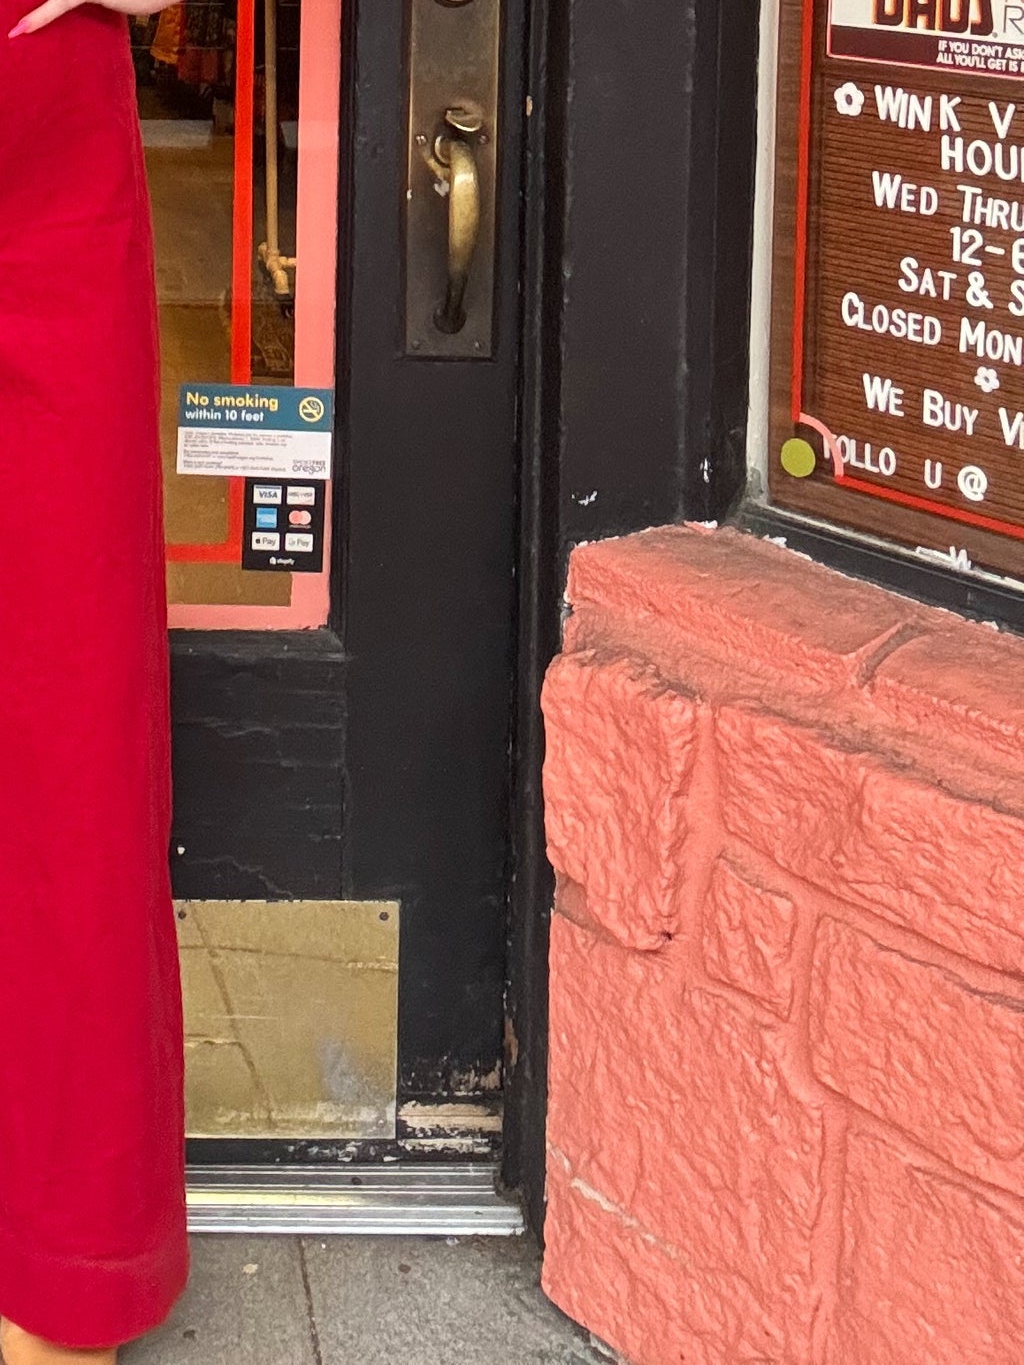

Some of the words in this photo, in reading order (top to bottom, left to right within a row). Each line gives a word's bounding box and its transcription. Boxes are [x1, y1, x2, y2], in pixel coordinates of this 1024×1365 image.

[938, 39, 948, 52] IF
[948, 40, 970, 54] YOU
[971, 43, 1003, 58] DON'T
[936, 51, 954, 65] ALL
[954, 54, 987, 69] YOU'LL
[987, 57, 1007, 71] GET
[1008, 59, 1019, 72] IS
[874, 84, 962, 132] WINK
[872, 170, 938, 216] WED
[957, 184, 1024, 232] THRU
[898, 256, 957, 301] SAT
[965, 271, 994, 309] &
[841, 291, 942, 346] CLOSED
[186, 392, 209, 406] No
[213, 393, 279, 411] smoking
[862, 372, 905, 417] WE
[923, 388, 979, 436] BUY
[185, 408, 222, 421] within
[225, 409, 238, 421] 10
[241, 409, 265, 422] feet
[957, 465, 988, 501] @
[258, 490, 278, 499] VISA
[262, 536, 276, 546] Pay
[296, 537, 310, 547] Pay
